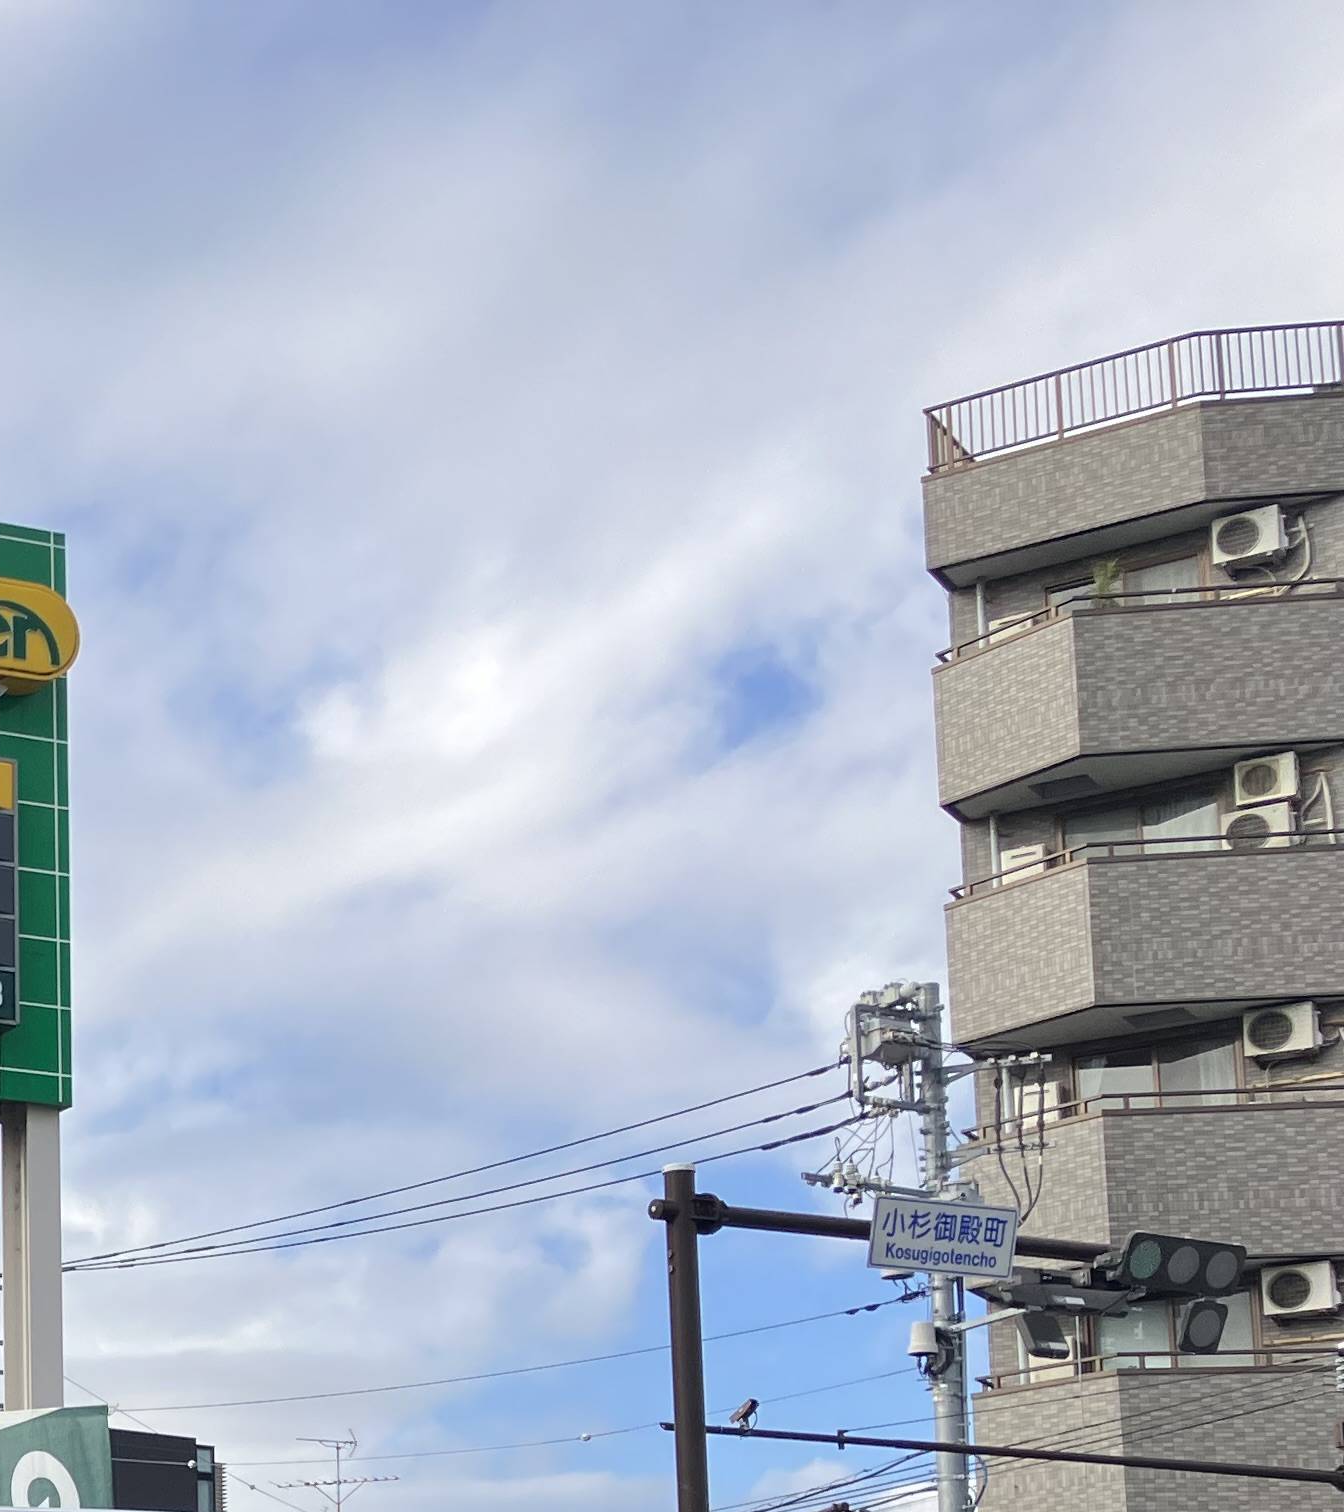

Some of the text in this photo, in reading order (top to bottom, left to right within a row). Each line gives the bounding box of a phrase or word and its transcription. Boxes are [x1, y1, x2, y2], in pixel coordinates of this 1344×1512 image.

[882, 1208, 1009, 1248] 小杉御殿町
[885, 1242, 997, 1268] Kosugigotencho
